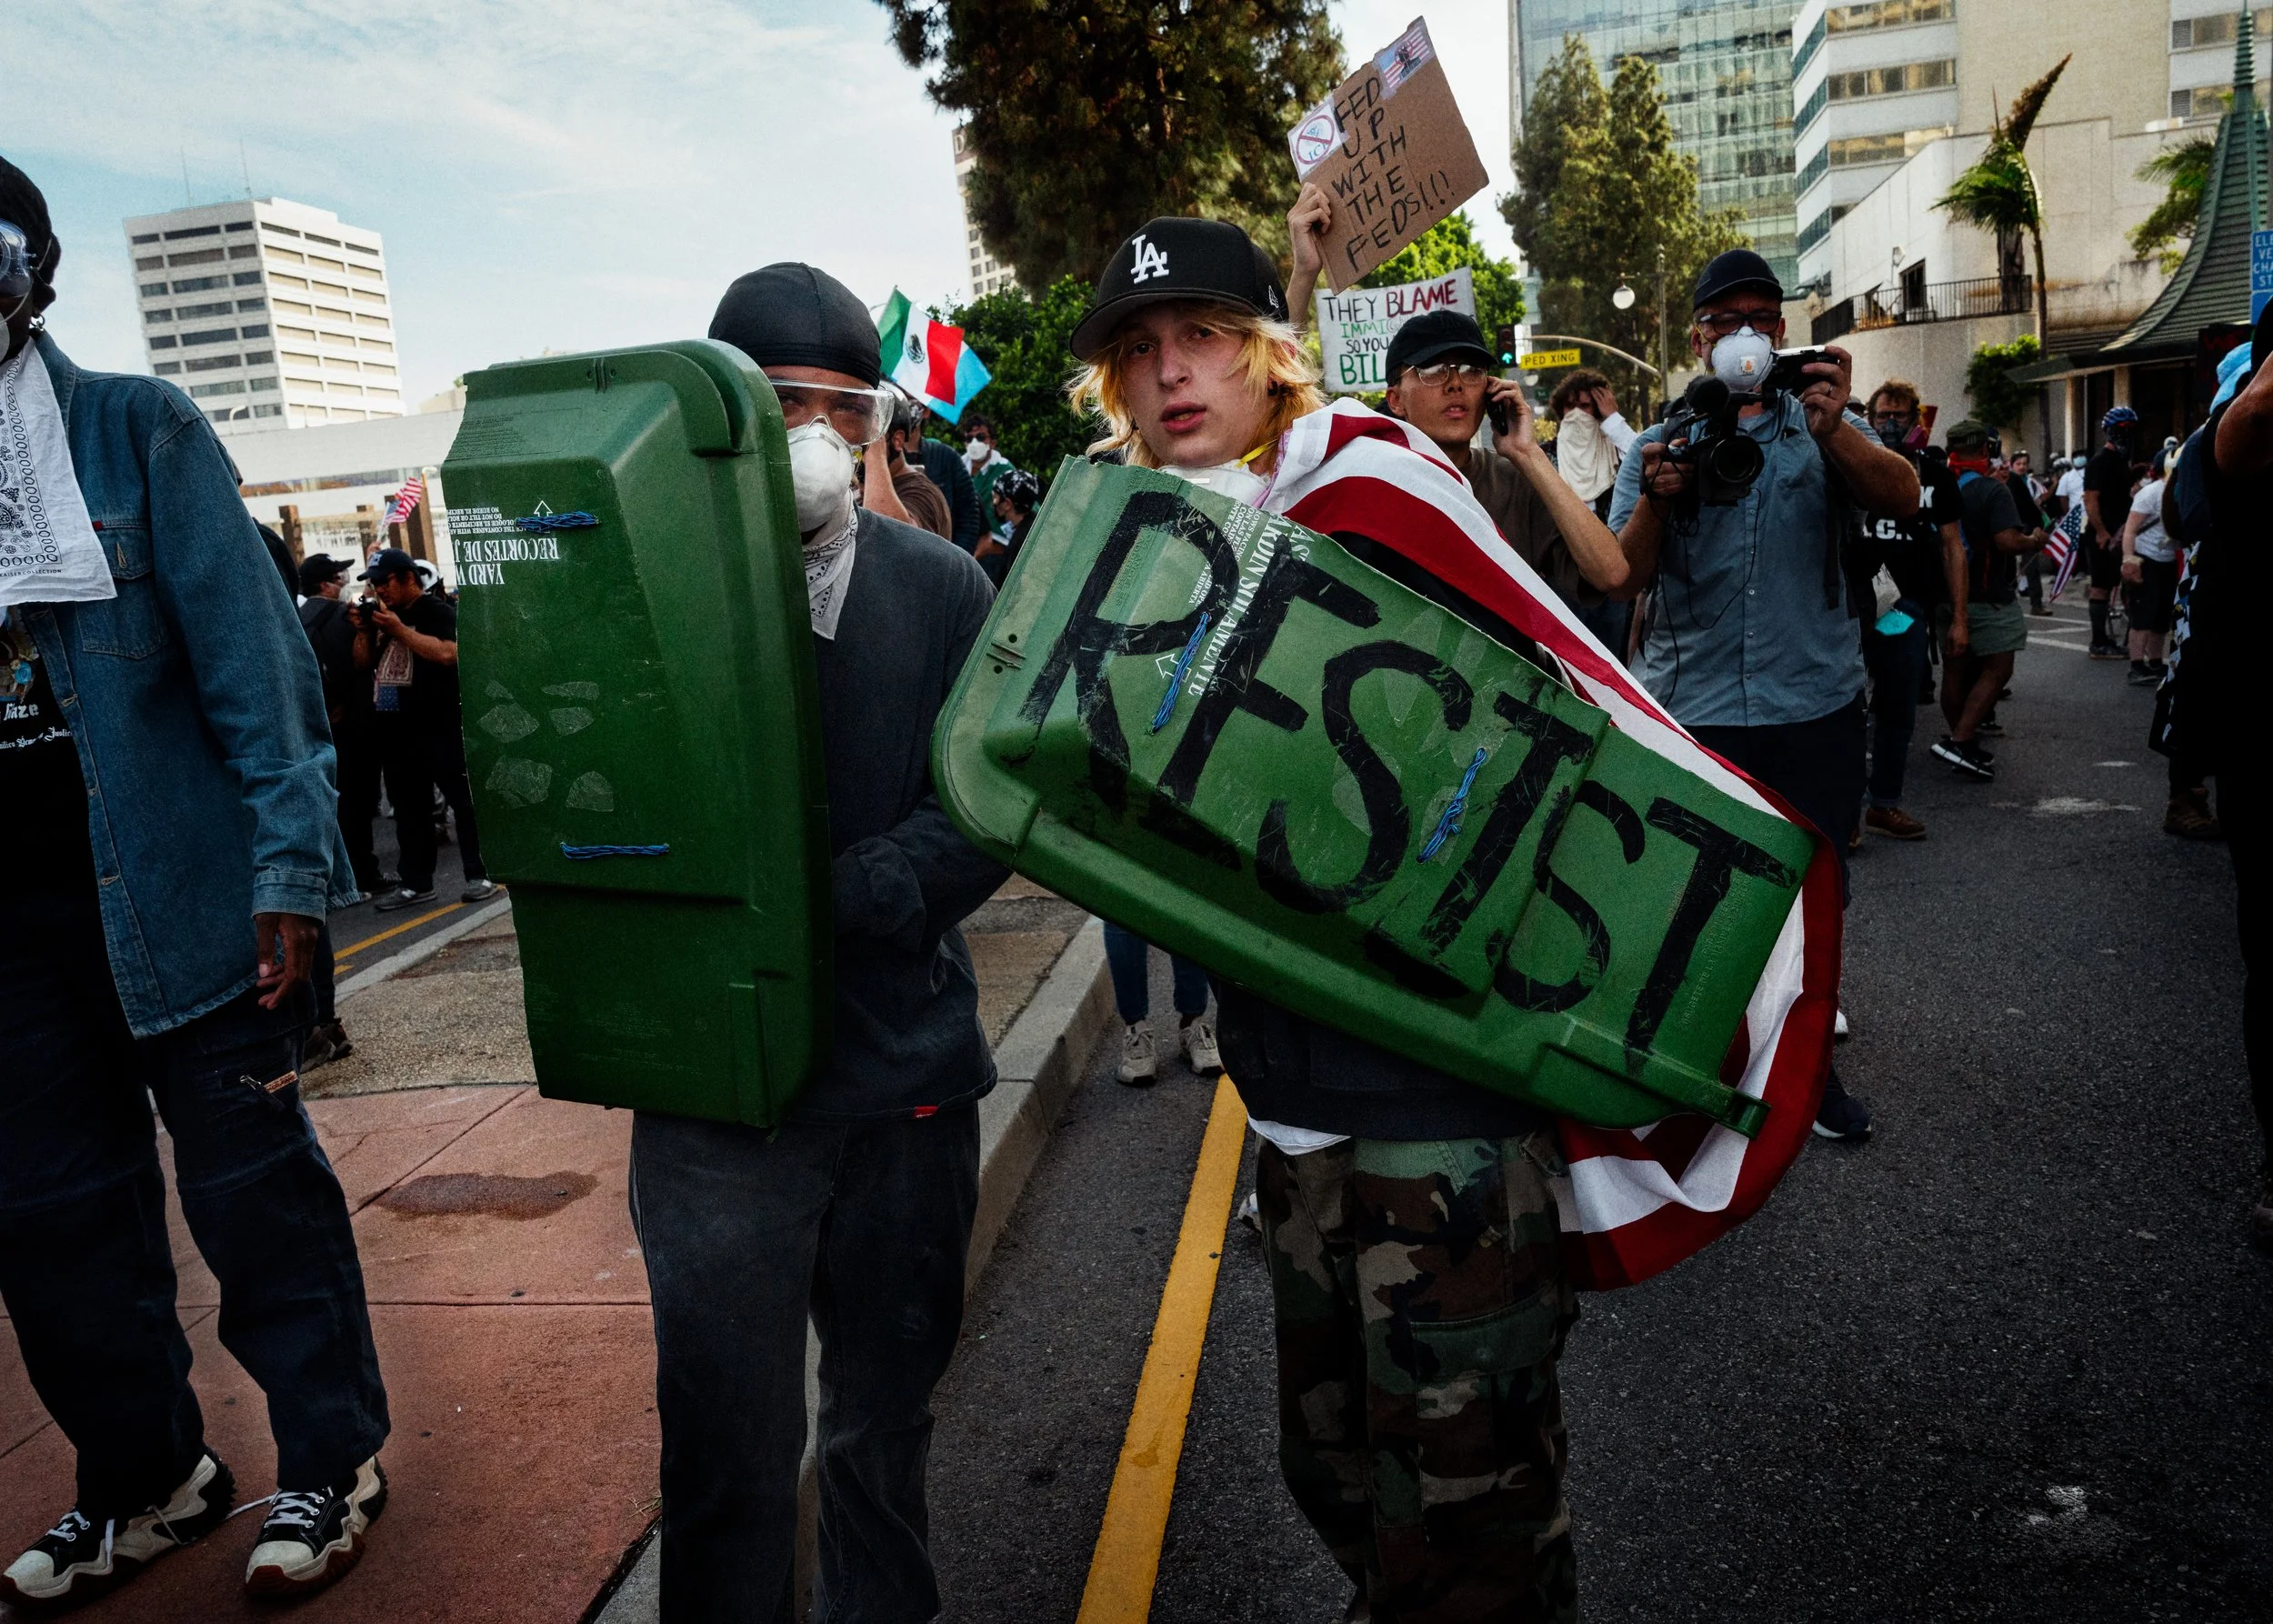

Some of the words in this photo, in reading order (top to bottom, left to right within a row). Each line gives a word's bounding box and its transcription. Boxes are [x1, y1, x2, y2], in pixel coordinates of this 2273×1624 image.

[1334, 76, 1380, 133] FED
[1343, 107, 1384, 158] UP
[1331, 125, 1407, 198] WITH
[1346, 165, 1405, 225] THE
[1130, 234, 1170, 284] LA
[1322, 296, 1377, 323] THEY
[1386, 279, 1457, 318] BLAME
[1524, 356, 1547, 366] PED
[1550, 353, 1575, 364] XING
[464, 540, 482, 562] DE
[469, 563, 505, 585] YARD
[484, 537, 559, 562] RECORTES
[1017, 490, 1797, 1074] RESIST
